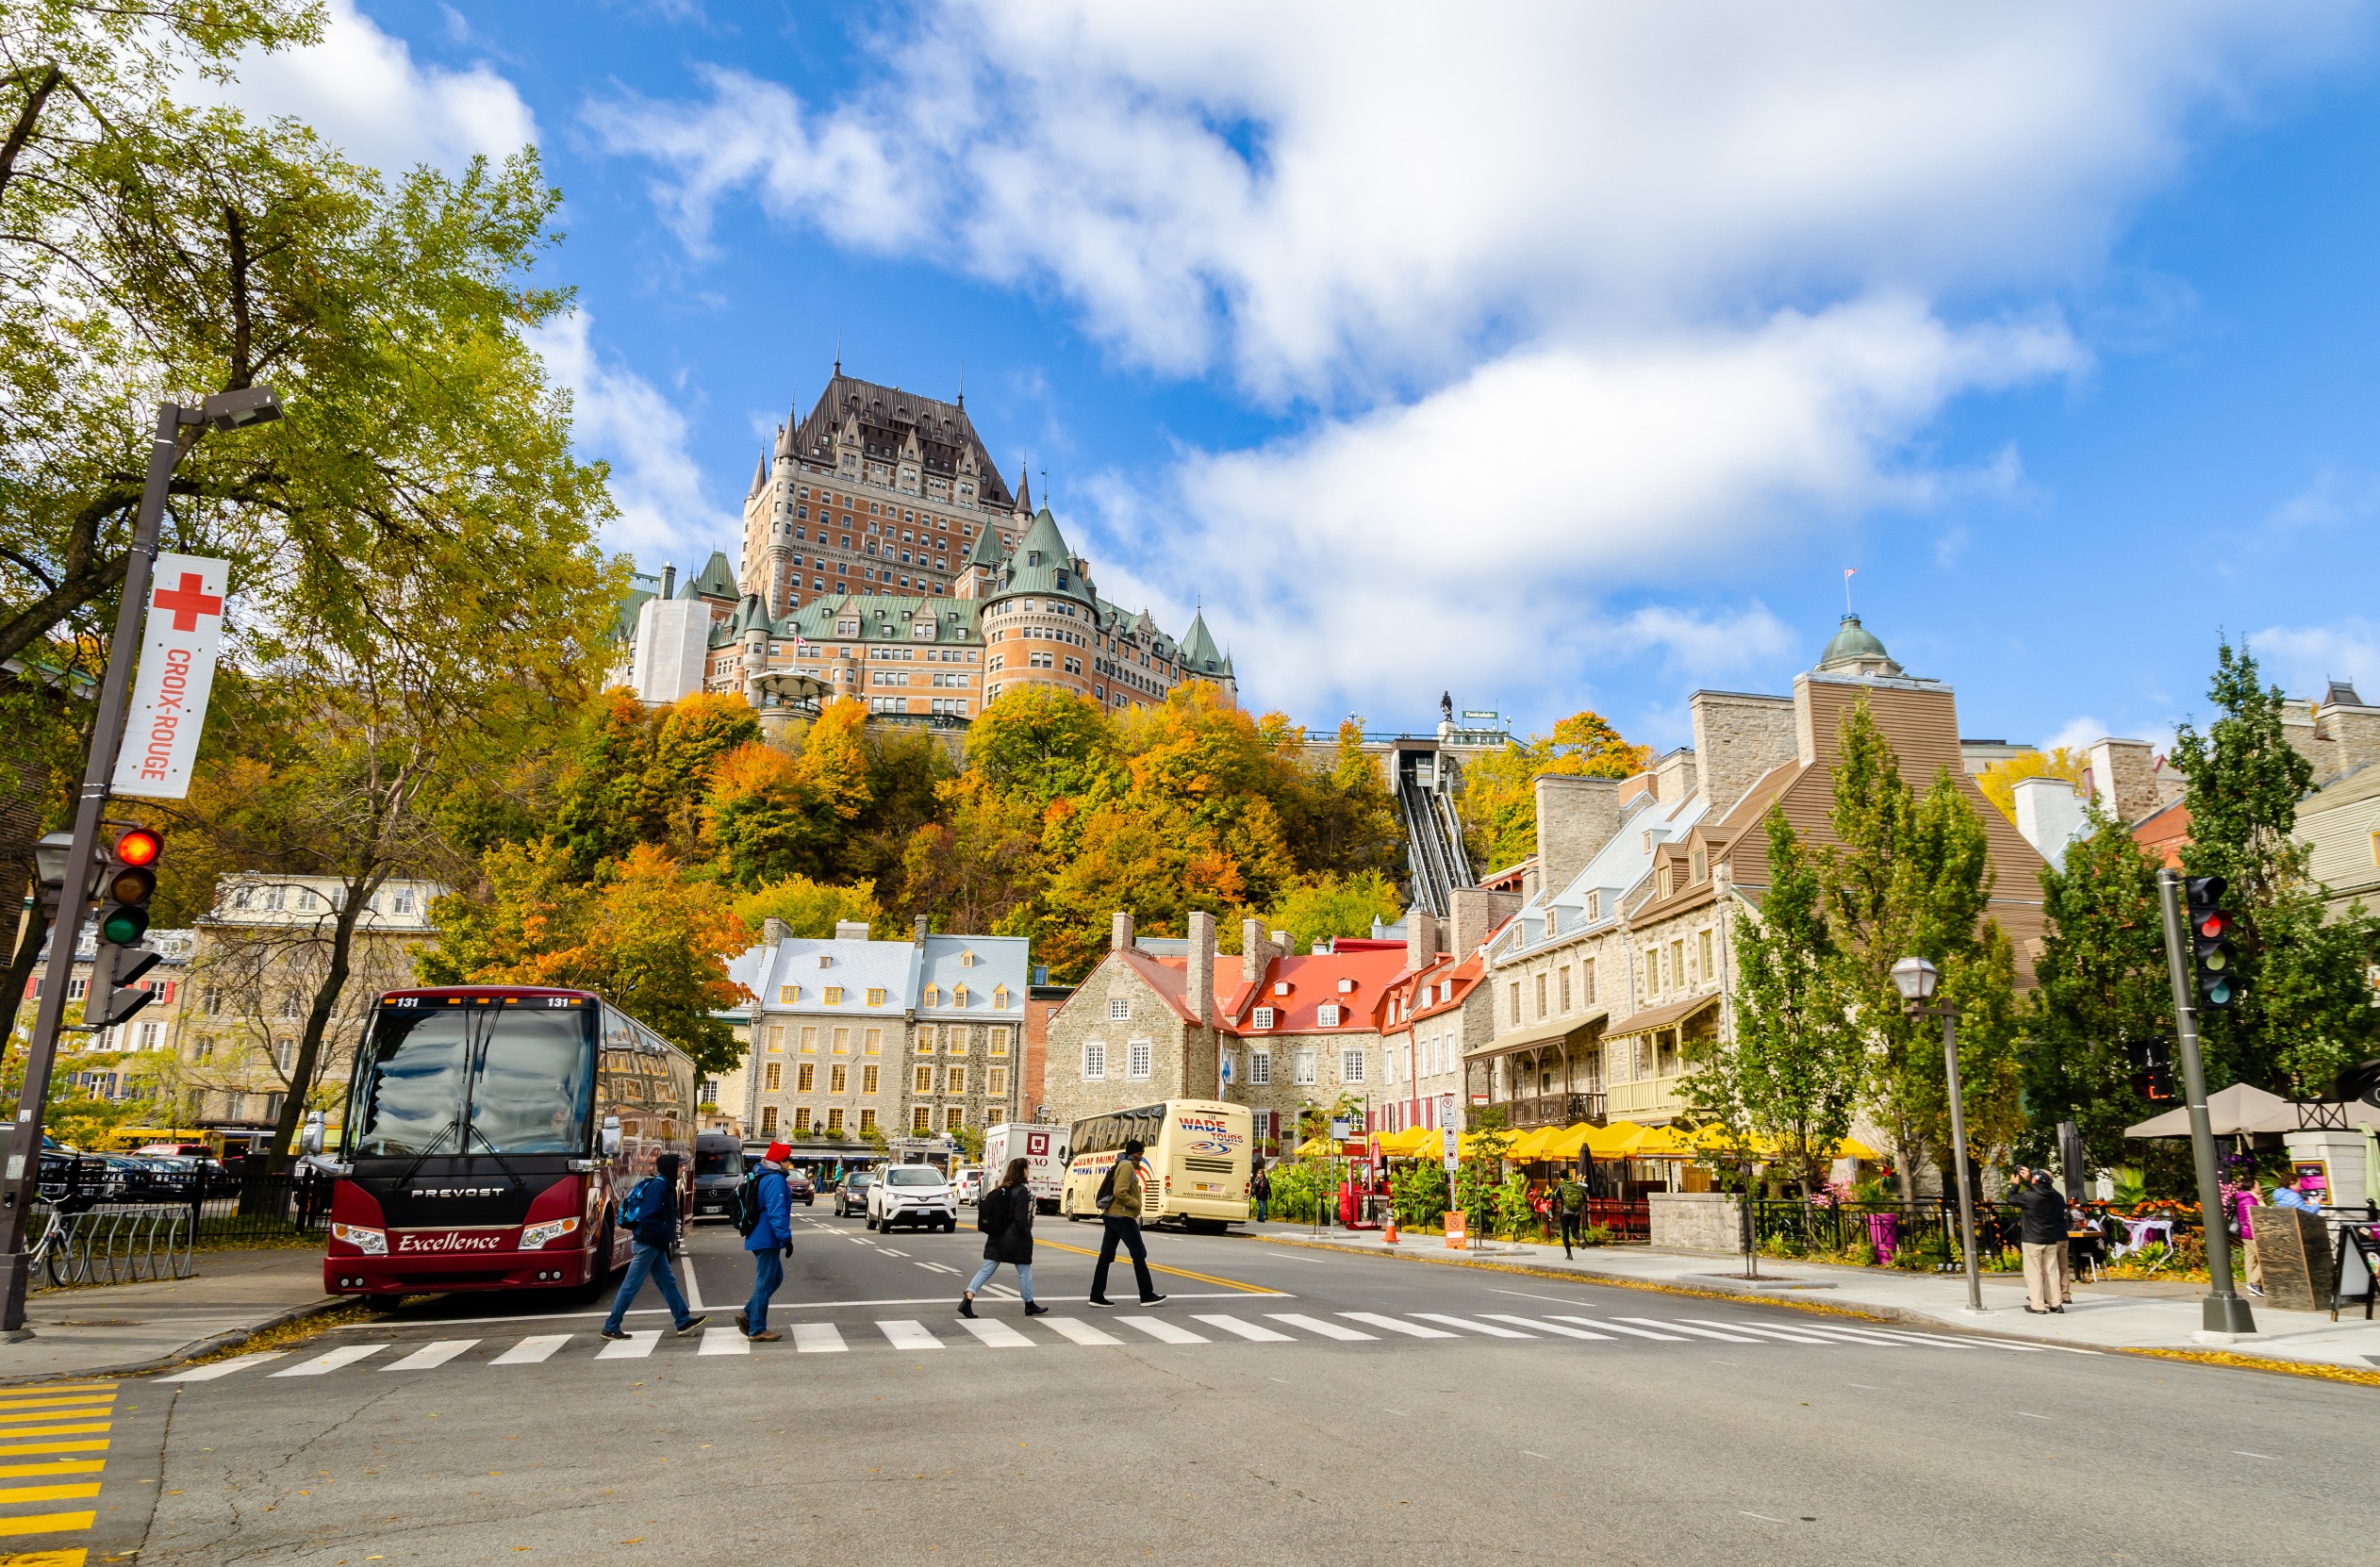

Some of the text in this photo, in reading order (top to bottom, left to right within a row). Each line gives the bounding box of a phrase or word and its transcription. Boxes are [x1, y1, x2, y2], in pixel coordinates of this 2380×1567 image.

[140, 649, 191, 782] CROIX-ROUGE
[397, 998, 419, 1008] 131
[547, 998, 569, 1008] 131
[1178, 1117, 1227, 1133] WADE
[1210, 1132, 1244, 1144] TOURS
[411, 1188, 504, 1198] PREVOST
[1182, 1192, 1232, 1200] www.wadetours.com
[398, 1231, 501, 1251] Excellence
